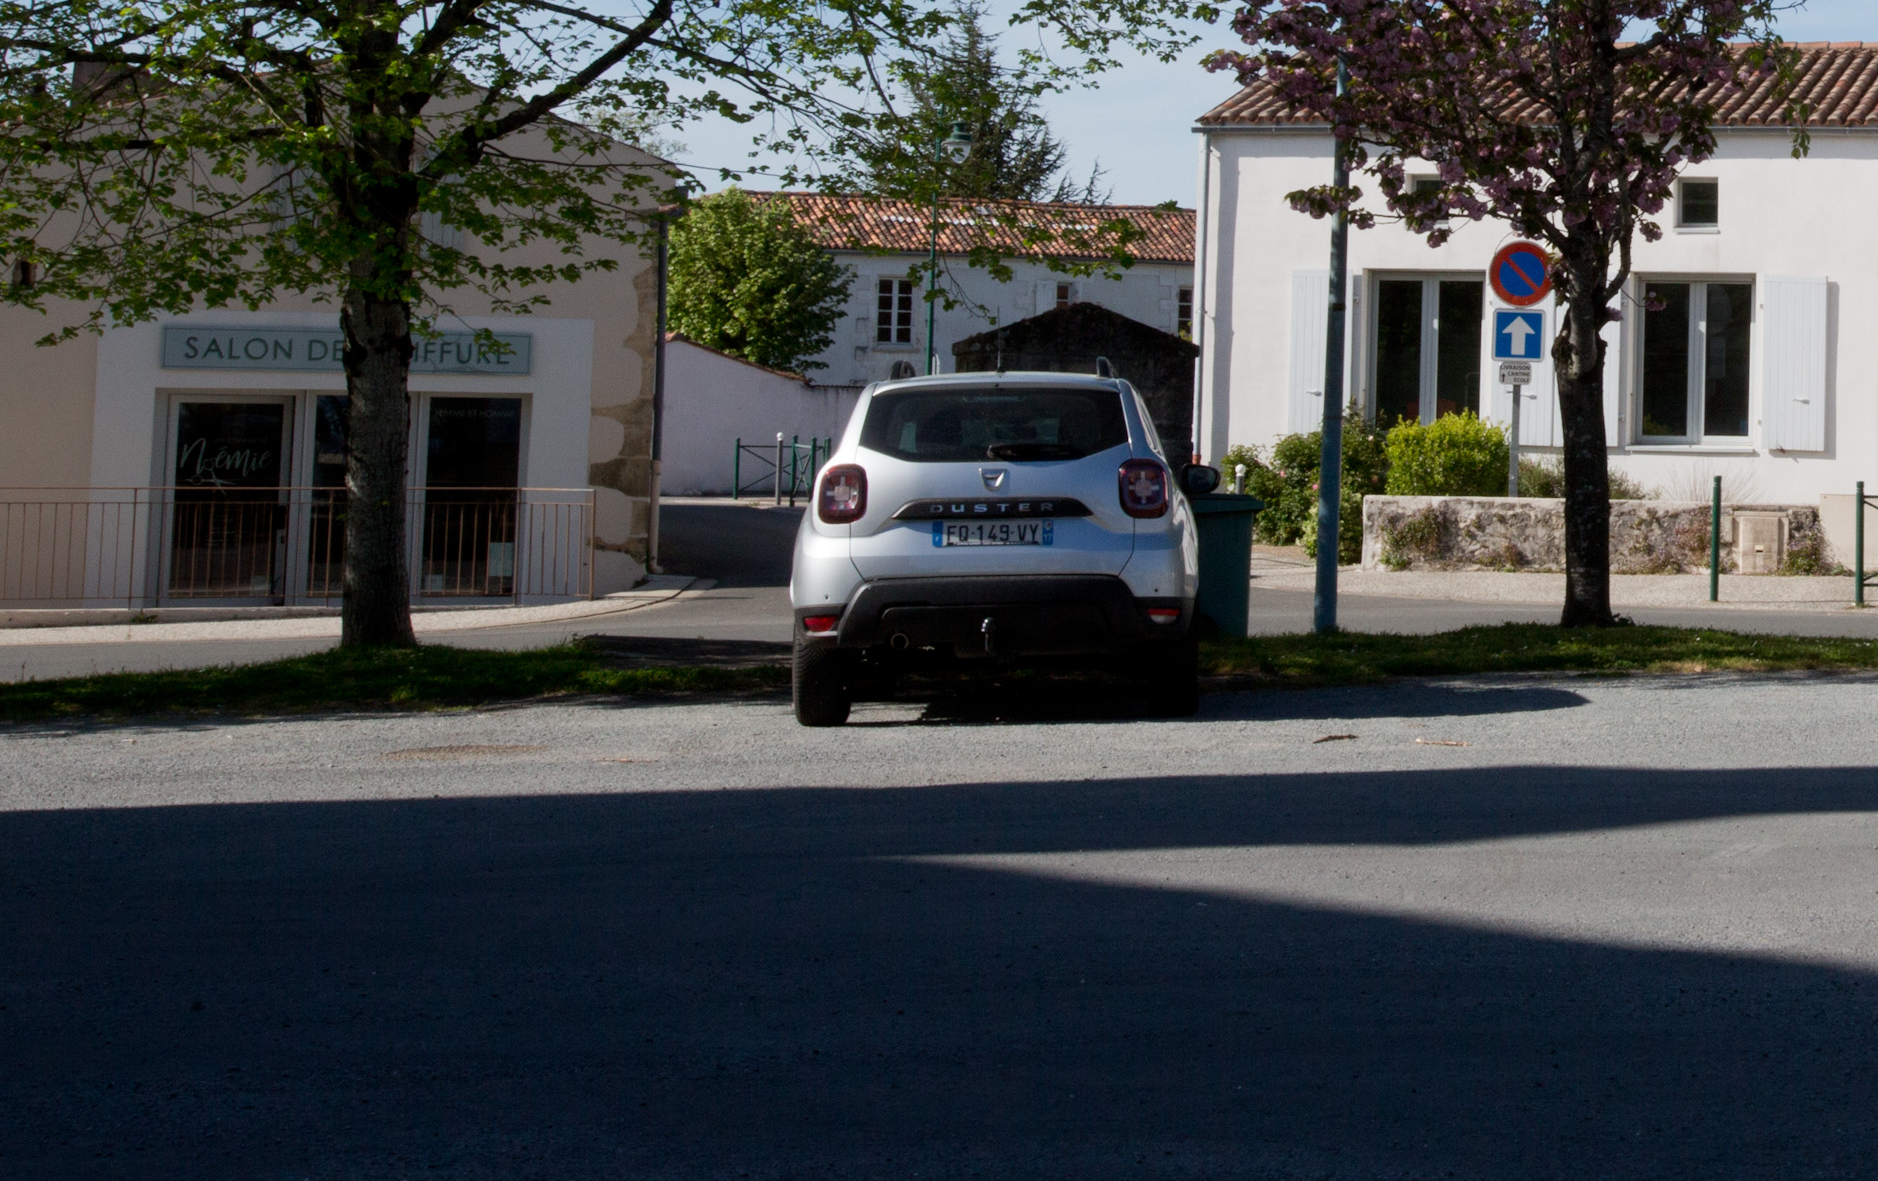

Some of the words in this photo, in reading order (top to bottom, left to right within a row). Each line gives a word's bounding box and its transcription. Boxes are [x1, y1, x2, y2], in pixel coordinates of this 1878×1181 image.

[184, 336, 293, 360] SALON
[412, 341, 510, 365] IFFURE
[930, 503, 1053, 512] DUSTER
[947, 525, 1039, 541] FQ-149-VY
